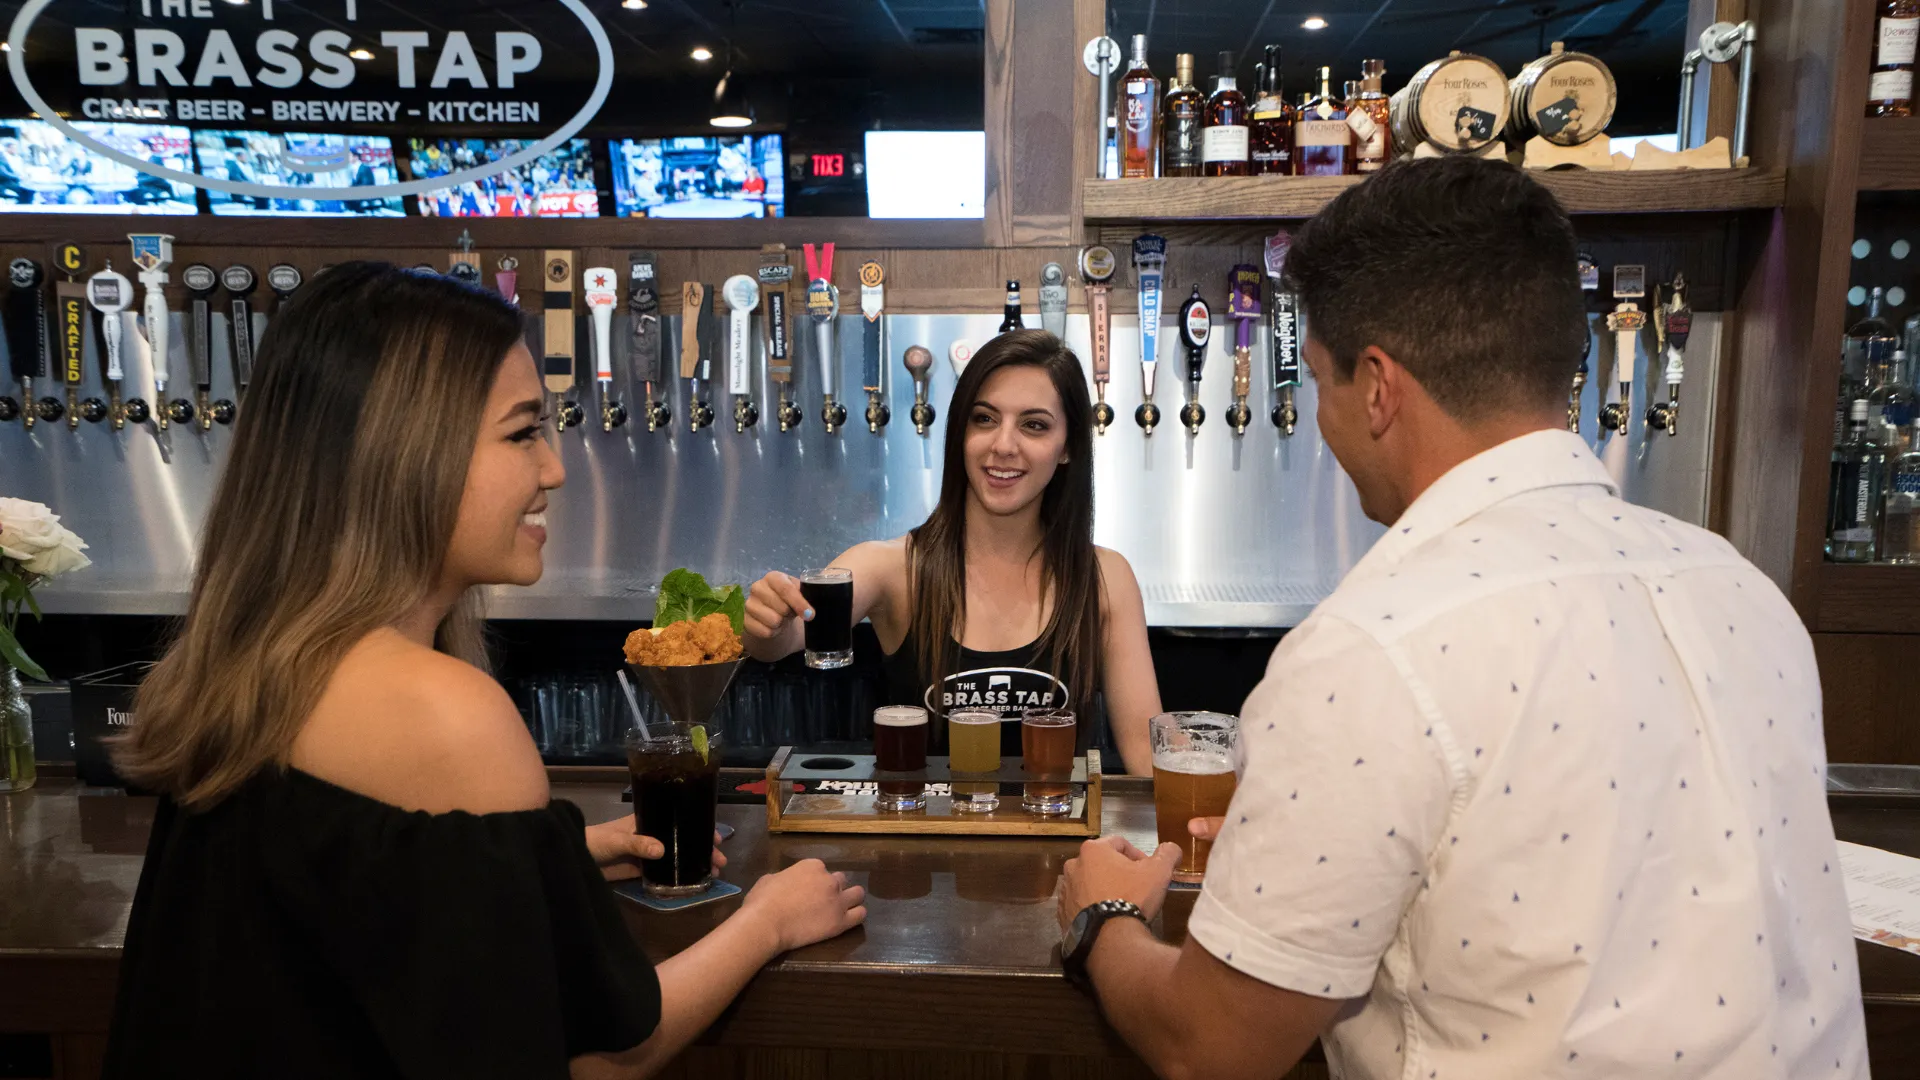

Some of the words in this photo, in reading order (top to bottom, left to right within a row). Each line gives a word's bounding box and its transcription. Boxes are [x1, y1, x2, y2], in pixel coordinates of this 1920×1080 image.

[75, 27, 356, 89] BRASS
[381, 31, 543, 89] TAP
[82, 98, 168, 119] CRAFT
[178, 100, 245, 121] BEER
[272, 101, 400, 122] BREWERY
[428, 102, 540, 123] KITCHEN
[64, 246, 81, 269] C
[759, 266, 788, 276] ESCAPE
[1144, 280, 1156, 307] COLD
[773, 296, 781, 325] SPECIAL
[1144, 308, 1156, 337] SNAP
[66, 301, 80, 382] CRAFTED
[775, 326, 784, 357] RELEASE
[1097, 303, 1106, 362] SIERRA
[735, 351, 744, 389] Moonlight
[1856, 480, 1869, 522] AMSTERDAM
[943, 691, 1008, 706] BRASS
[1015, 690, 1053, 706] TAP
[957, 682, 976, 691] THE
[815, 780, 878, 791] Fou
